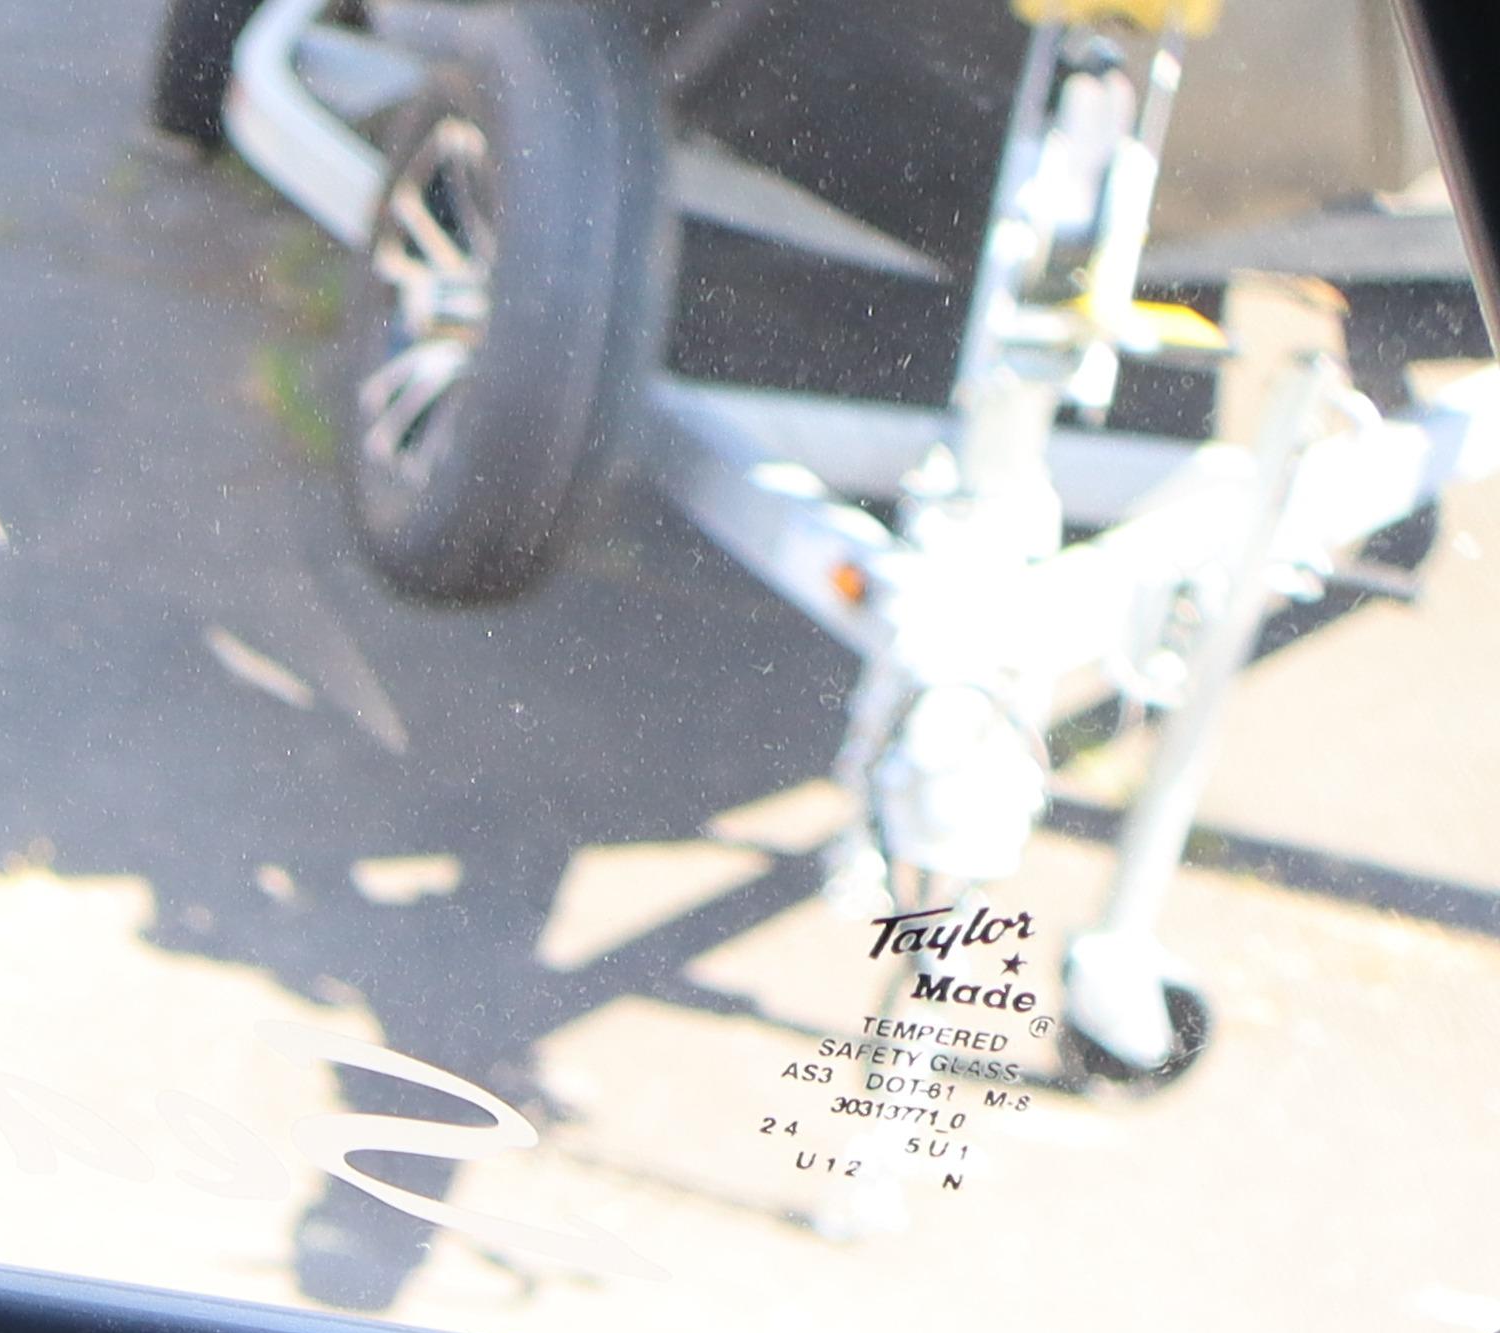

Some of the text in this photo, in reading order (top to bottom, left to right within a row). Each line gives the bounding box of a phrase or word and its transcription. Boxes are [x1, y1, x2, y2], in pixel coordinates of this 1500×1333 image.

[868, 907, 1036, 960] Taylor
[910, 973, 1036, 1013] Made
[863, 1016, 1008, 1052] TEMPERED
[781, 1061, 833, 1084] AS3
[819, 1038, 1022, 1082] SAFETY GLASS
[942, 1173, 963, 1190] N
